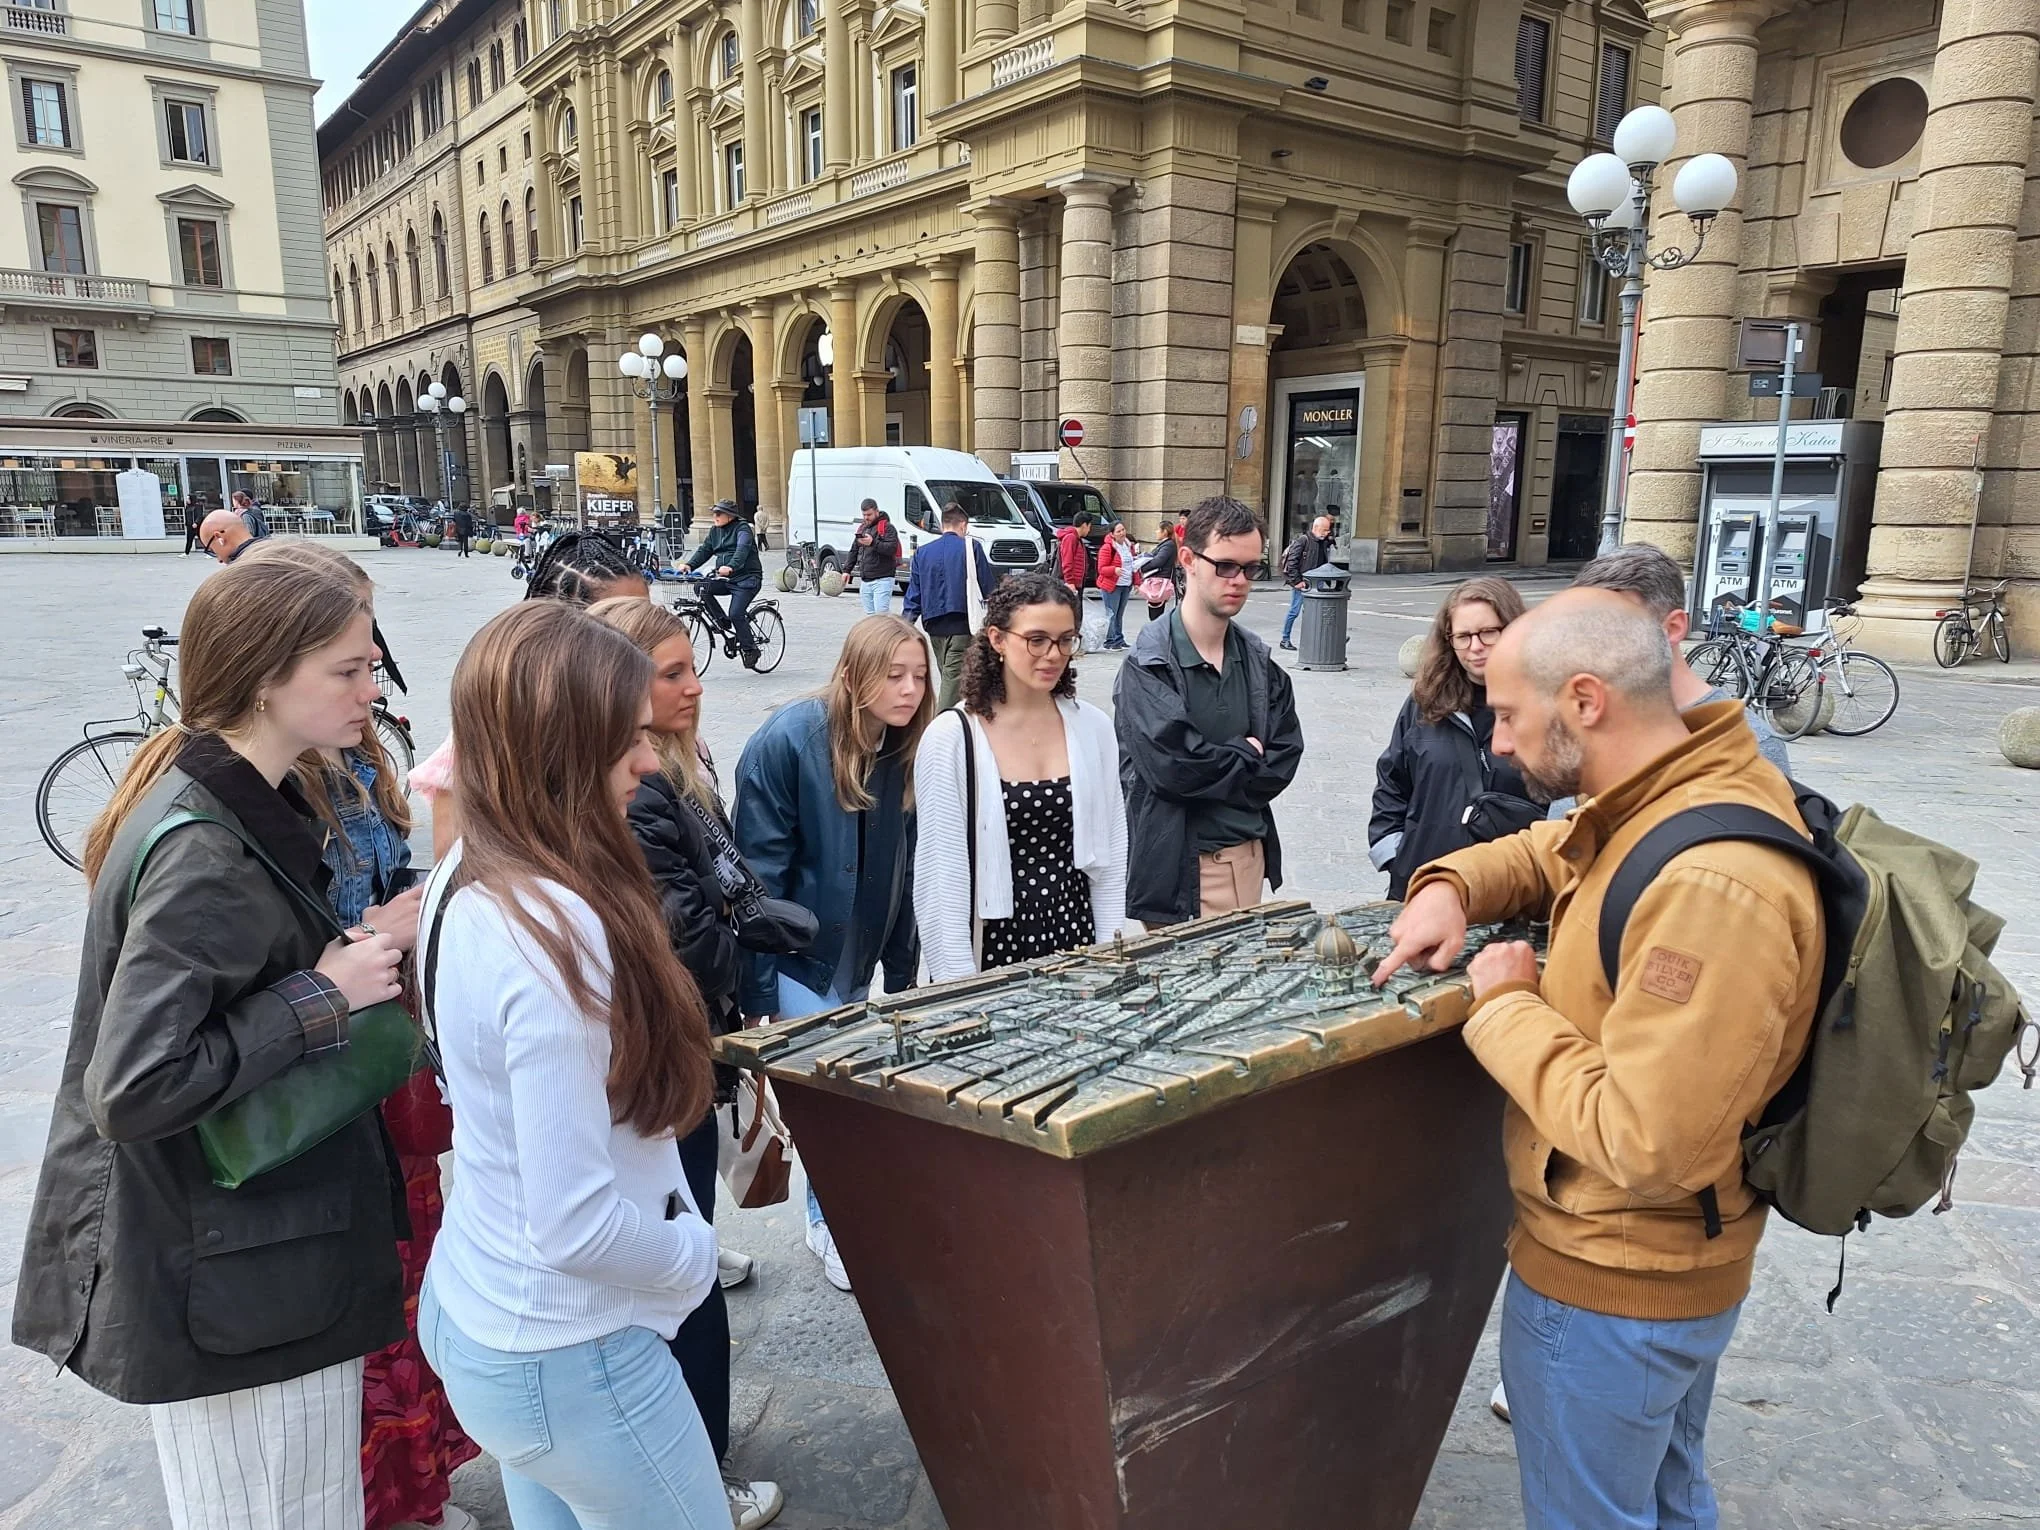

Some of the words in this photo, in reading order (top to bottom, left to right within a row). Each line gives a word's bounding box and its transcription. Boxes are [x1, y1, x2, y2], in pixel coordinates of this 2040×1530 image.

[1303, 408, 1353, 423] MONCLER
[100, 435, 142, 444] VINERIA
[150, 435, 165, 445] RE
[277, 441, 313, 449] PIZZERIA
[1787, 431, 1839, 447] Katia
[1020, 465, 1049, 480] VOGUE
[587, 499, 634, 512] KIEFER
[1719, 576, 1743, 586] ATM
[1772, 579, 1798, 589] ATM
[690, 798, 741, 865] lululemon
